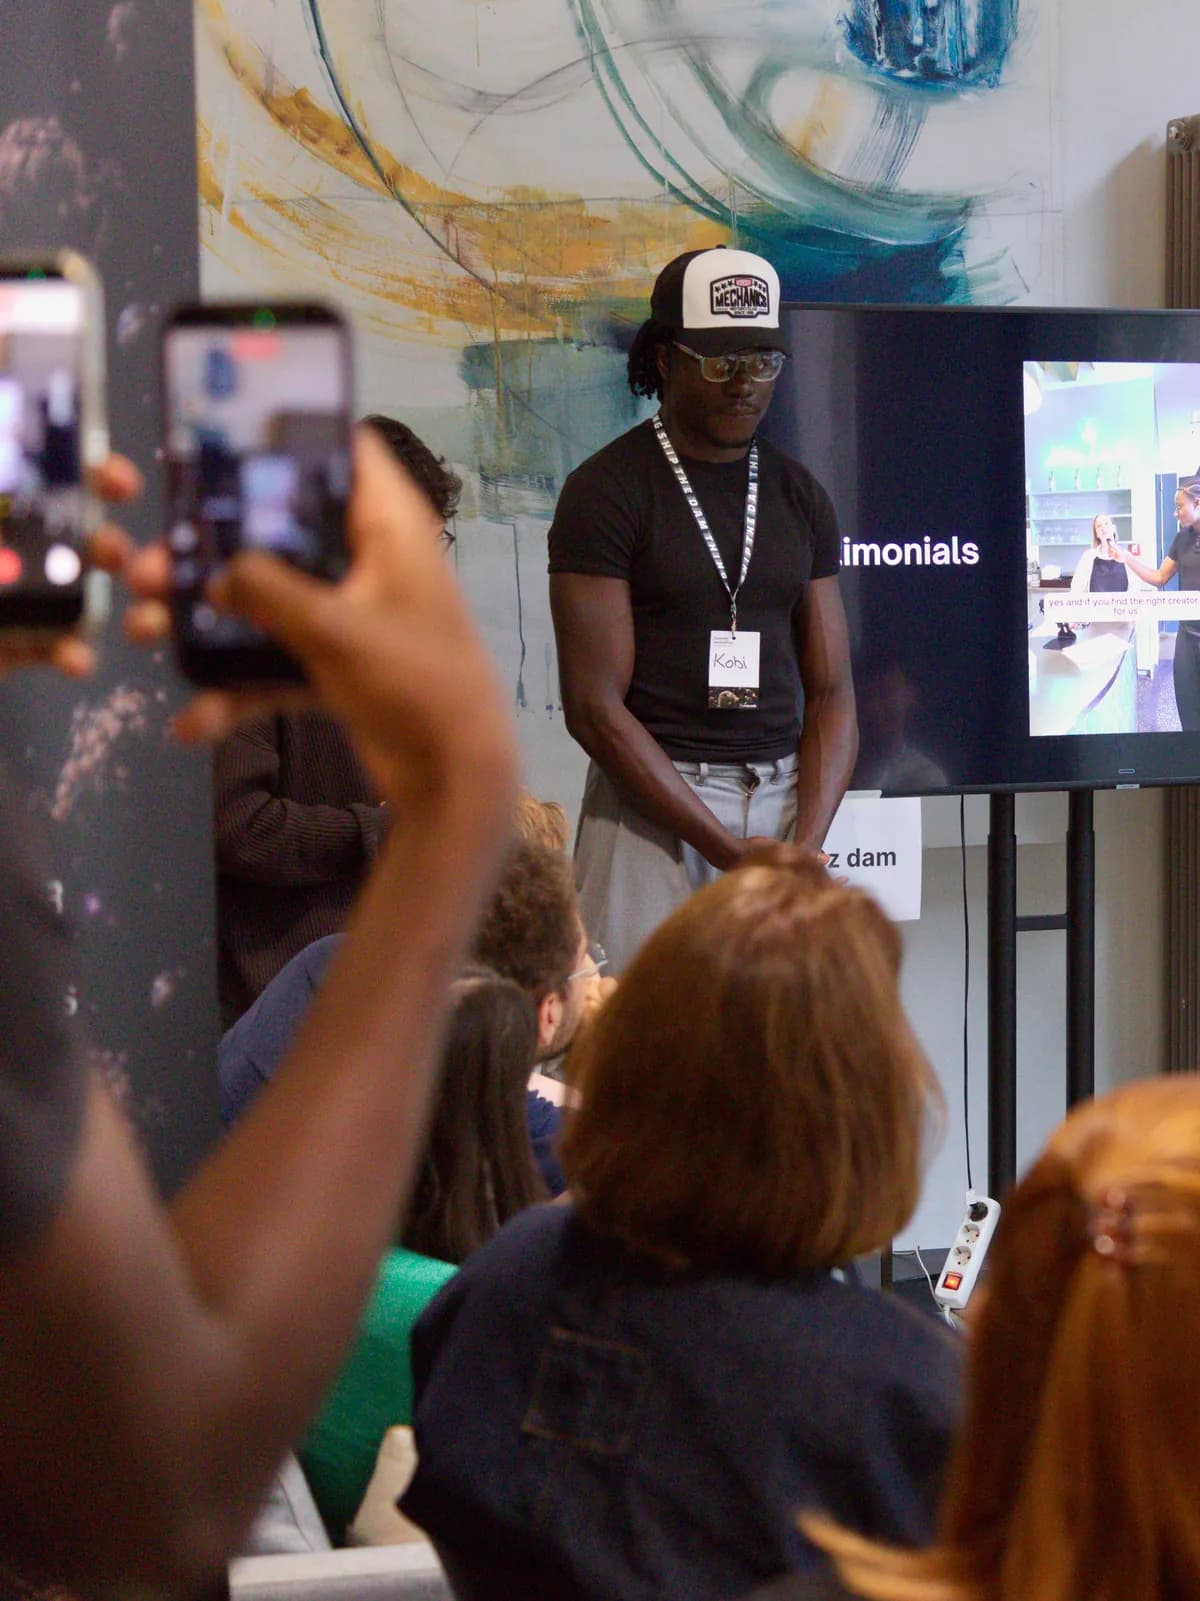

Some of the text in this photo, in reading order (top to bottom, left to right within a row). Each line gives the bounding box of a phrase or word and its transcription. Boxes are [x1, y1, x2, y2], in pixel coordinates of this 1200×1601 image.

[715, 287, 767, 308] MECHANICS
[657, 432, 679, 464] SHIP
[674, 467, 693, 494] THE
[688, 498, 709, 530] DAM
[747, 482, 758, 514] DAM
[745, 516, 756, 544] THE
[840, 535, 980, 567] imonials
[1049, 597, 1198, 608] yes and if you find the right creator
[1113, 607, 1126, 616] for
[713, 652, 748, 669] Kobi
[847, 848, 897, 868] dam
